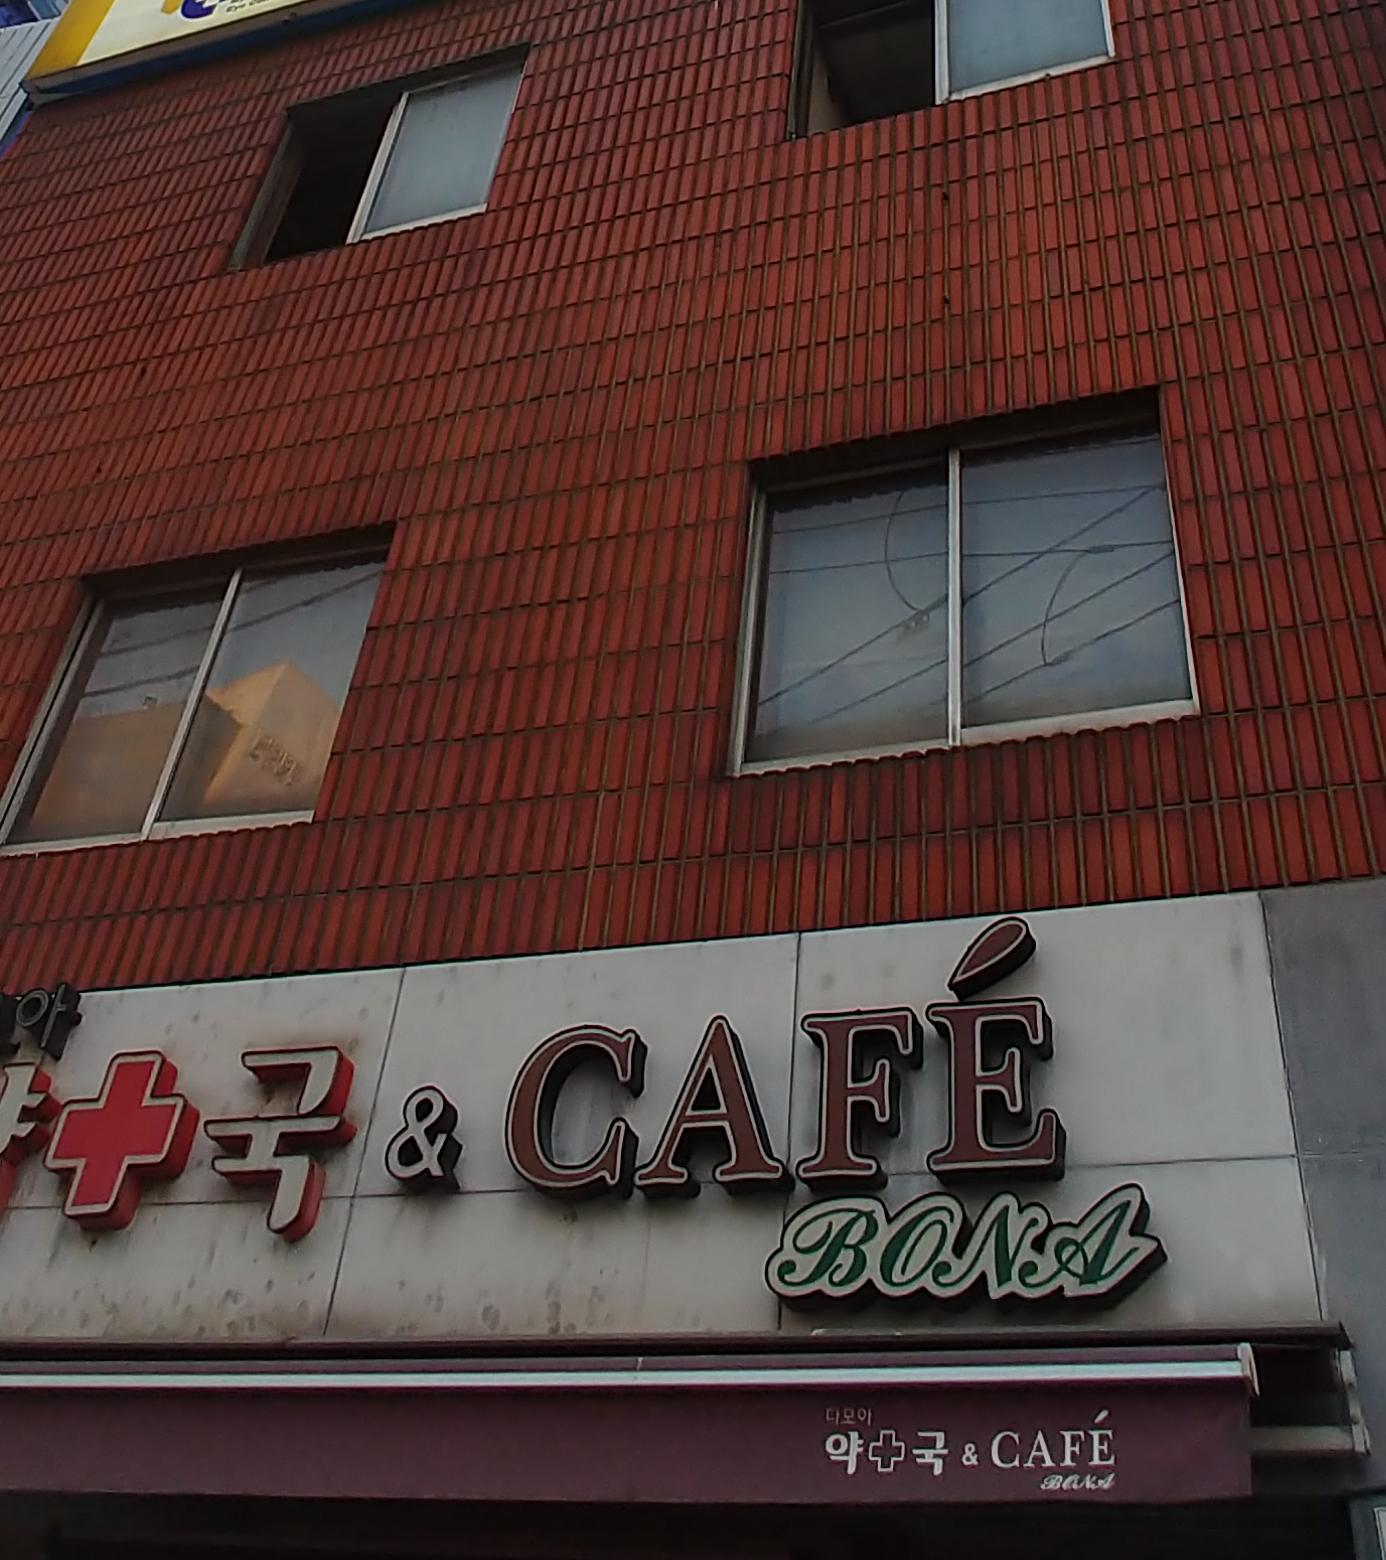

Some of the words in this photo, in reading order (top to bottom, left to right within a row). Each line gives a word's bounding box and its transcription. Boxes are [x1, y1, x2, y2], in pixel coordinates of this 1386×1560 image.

[386, 1086, 457, 1184] &
[504, 916, 1063, 1192] CAFÉ
[769, 1184, 1155, 1300] BONA
[825, 1407, 872, 1426] 다모아
[962, 1443, 979, 1465] &
[991, 1409, 1115, 1468] CAFÉ
[1040, 1473, 1115, 1491] BONA
